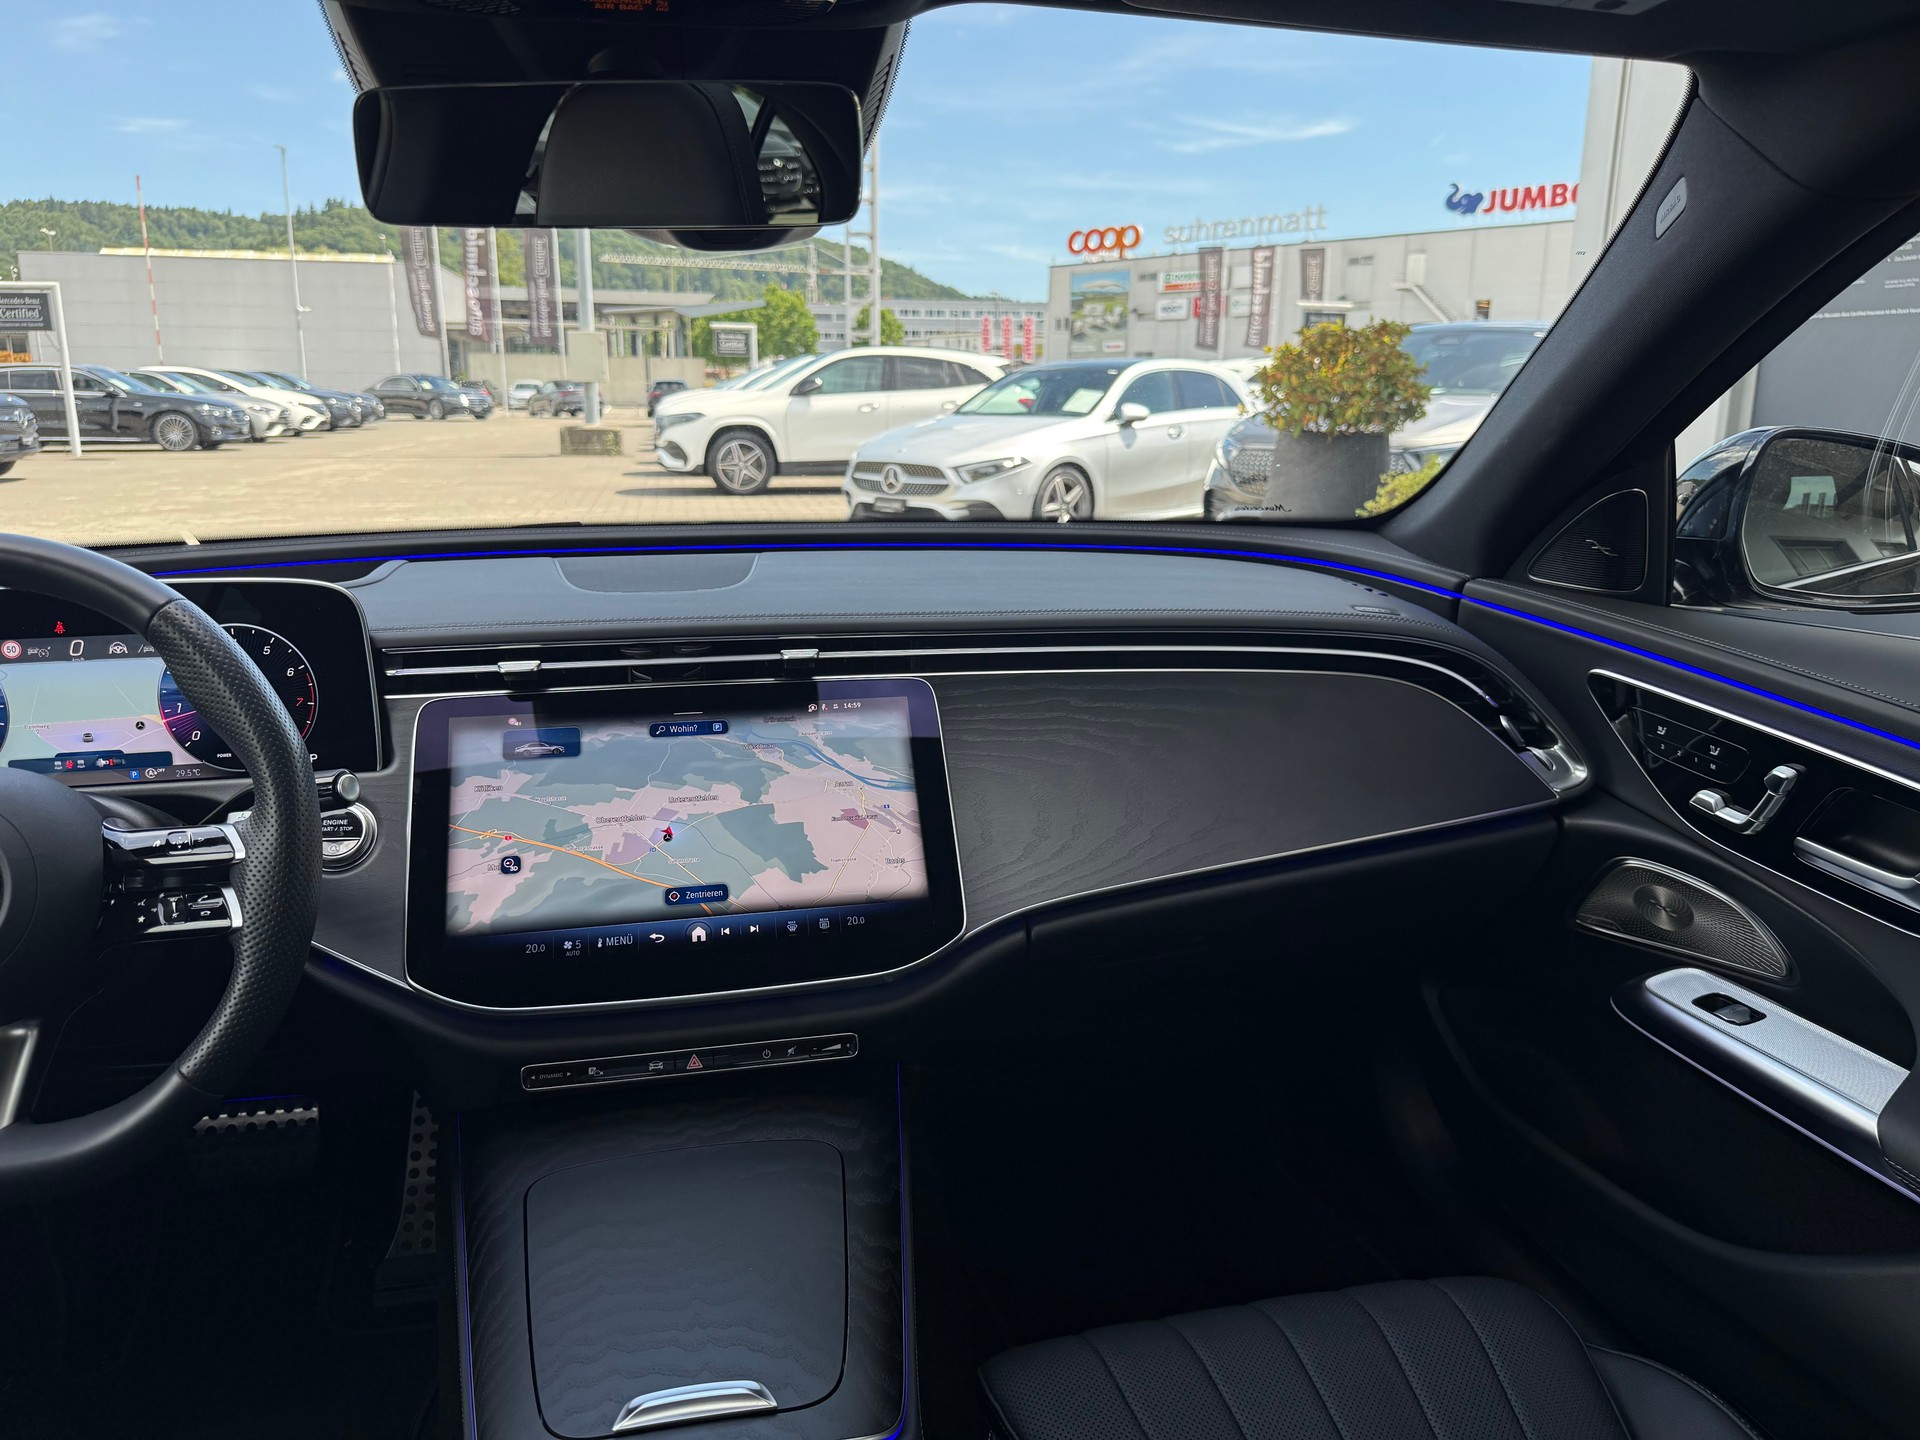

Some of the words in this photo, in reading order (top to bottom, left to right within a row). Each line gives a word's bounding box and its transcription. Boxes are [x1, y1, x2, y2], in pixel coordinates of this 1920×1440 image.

[1163, 204, 1328, 244] suhrenmatt
[1069, 225, 1141, 259] coop
[0, 308, 40, 318] Certified
[6, 645, 17, 654] 50
[69, 639, 84, 656] 0
[263, 646, 271, 655] 5
[286, 667, 295, 677] 6
[296, 698, 304, 706] 7
[176, 703, 182, 713] 1
[669, 724, 698, 733] Wohin?
[191, 730, 201, 741] 0
[310, 754, 318, 763] P
[131, 770, 138, 778] P
[596, 814, 646, 825] Oberentfelden
[685, 890, 724, 899] Zentrieren
[847, 916, 865, 925] 20.0
[575, 940, 582, 949] 5
[606, 934, 633, 947] MENÜ
[525, 944, 546, 954] 20.0
